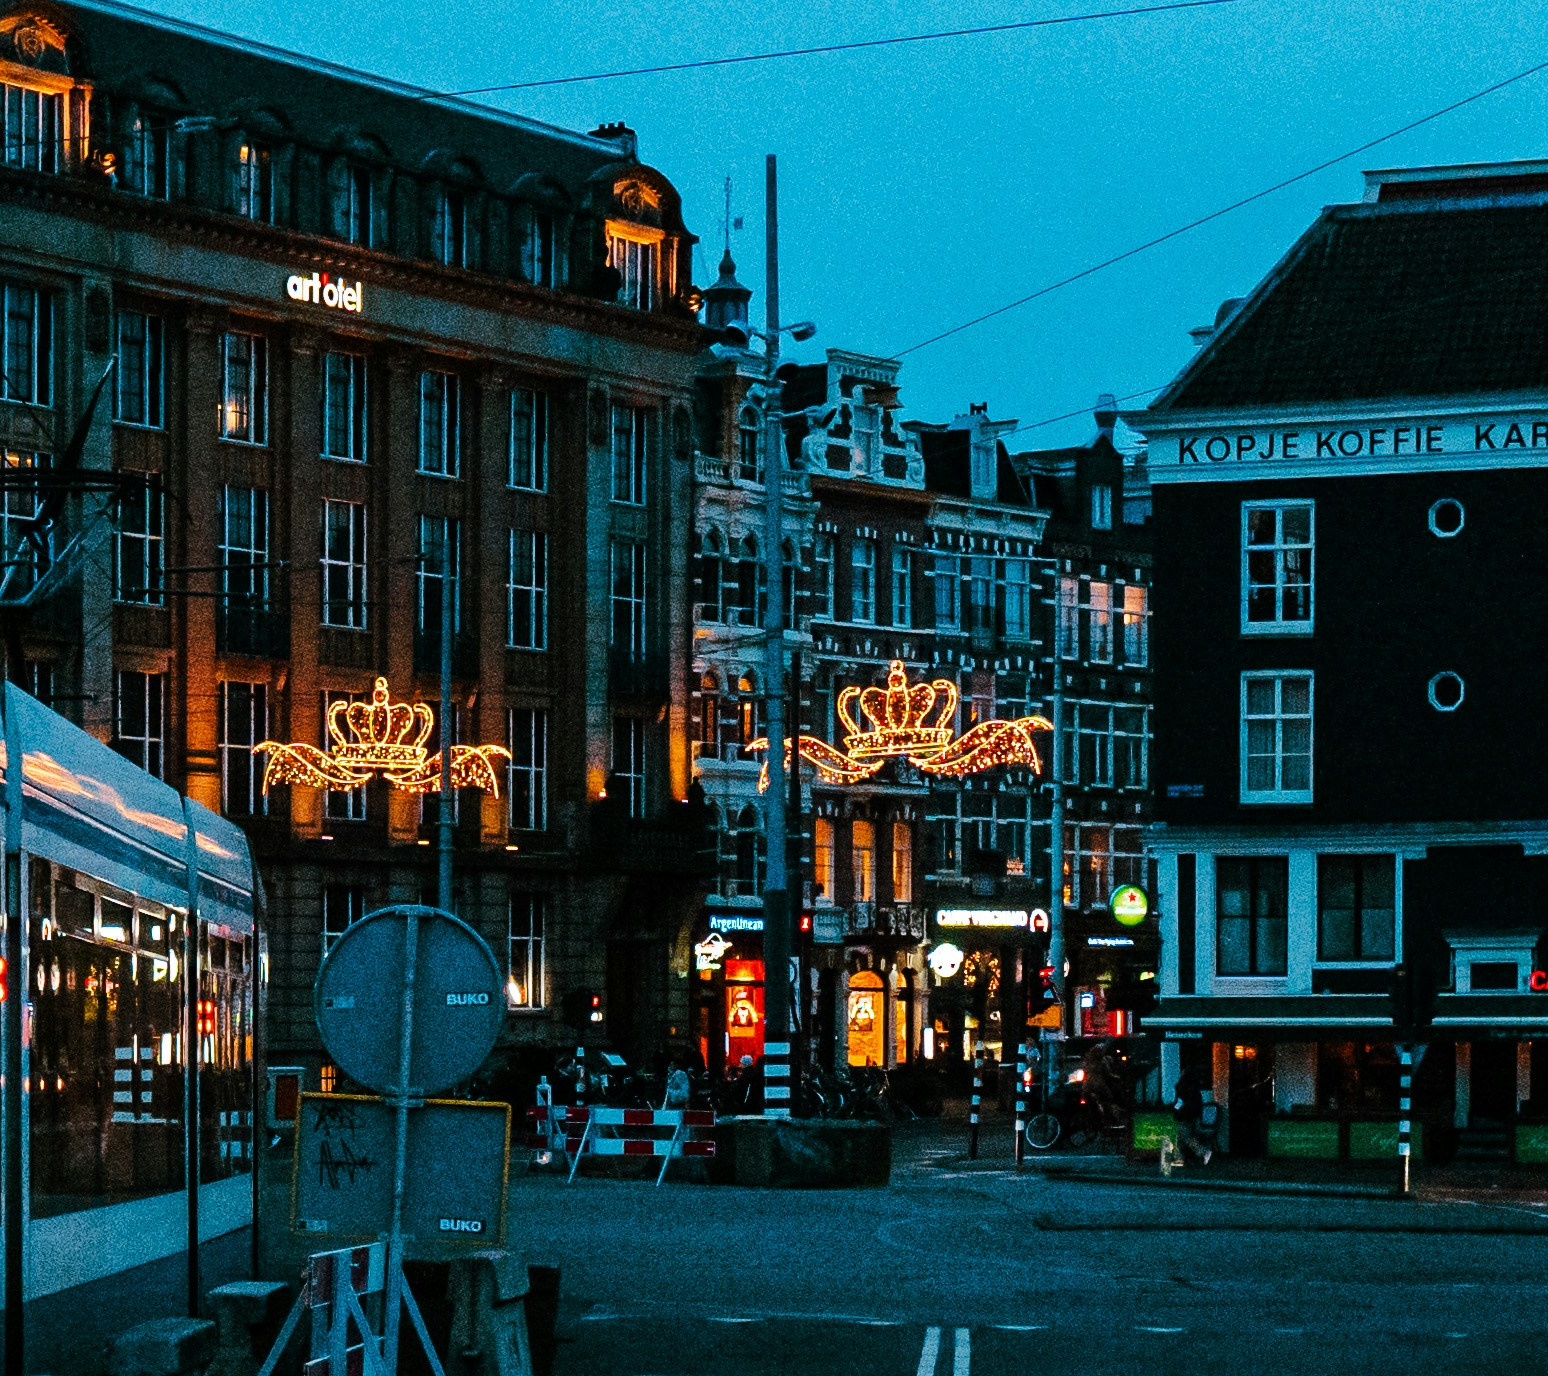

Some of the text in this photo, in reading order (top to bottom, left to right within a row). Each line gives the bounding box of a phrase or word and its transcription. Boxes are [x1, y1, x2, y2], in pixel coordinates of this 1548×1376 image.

[1178, 433, 1300, 464] KOPJE
[1316, 426, 1445, 458] KOFFIE
[445, 992, 490, 1006] BUKO
[439, 1218, 483, 1233] BUKO
